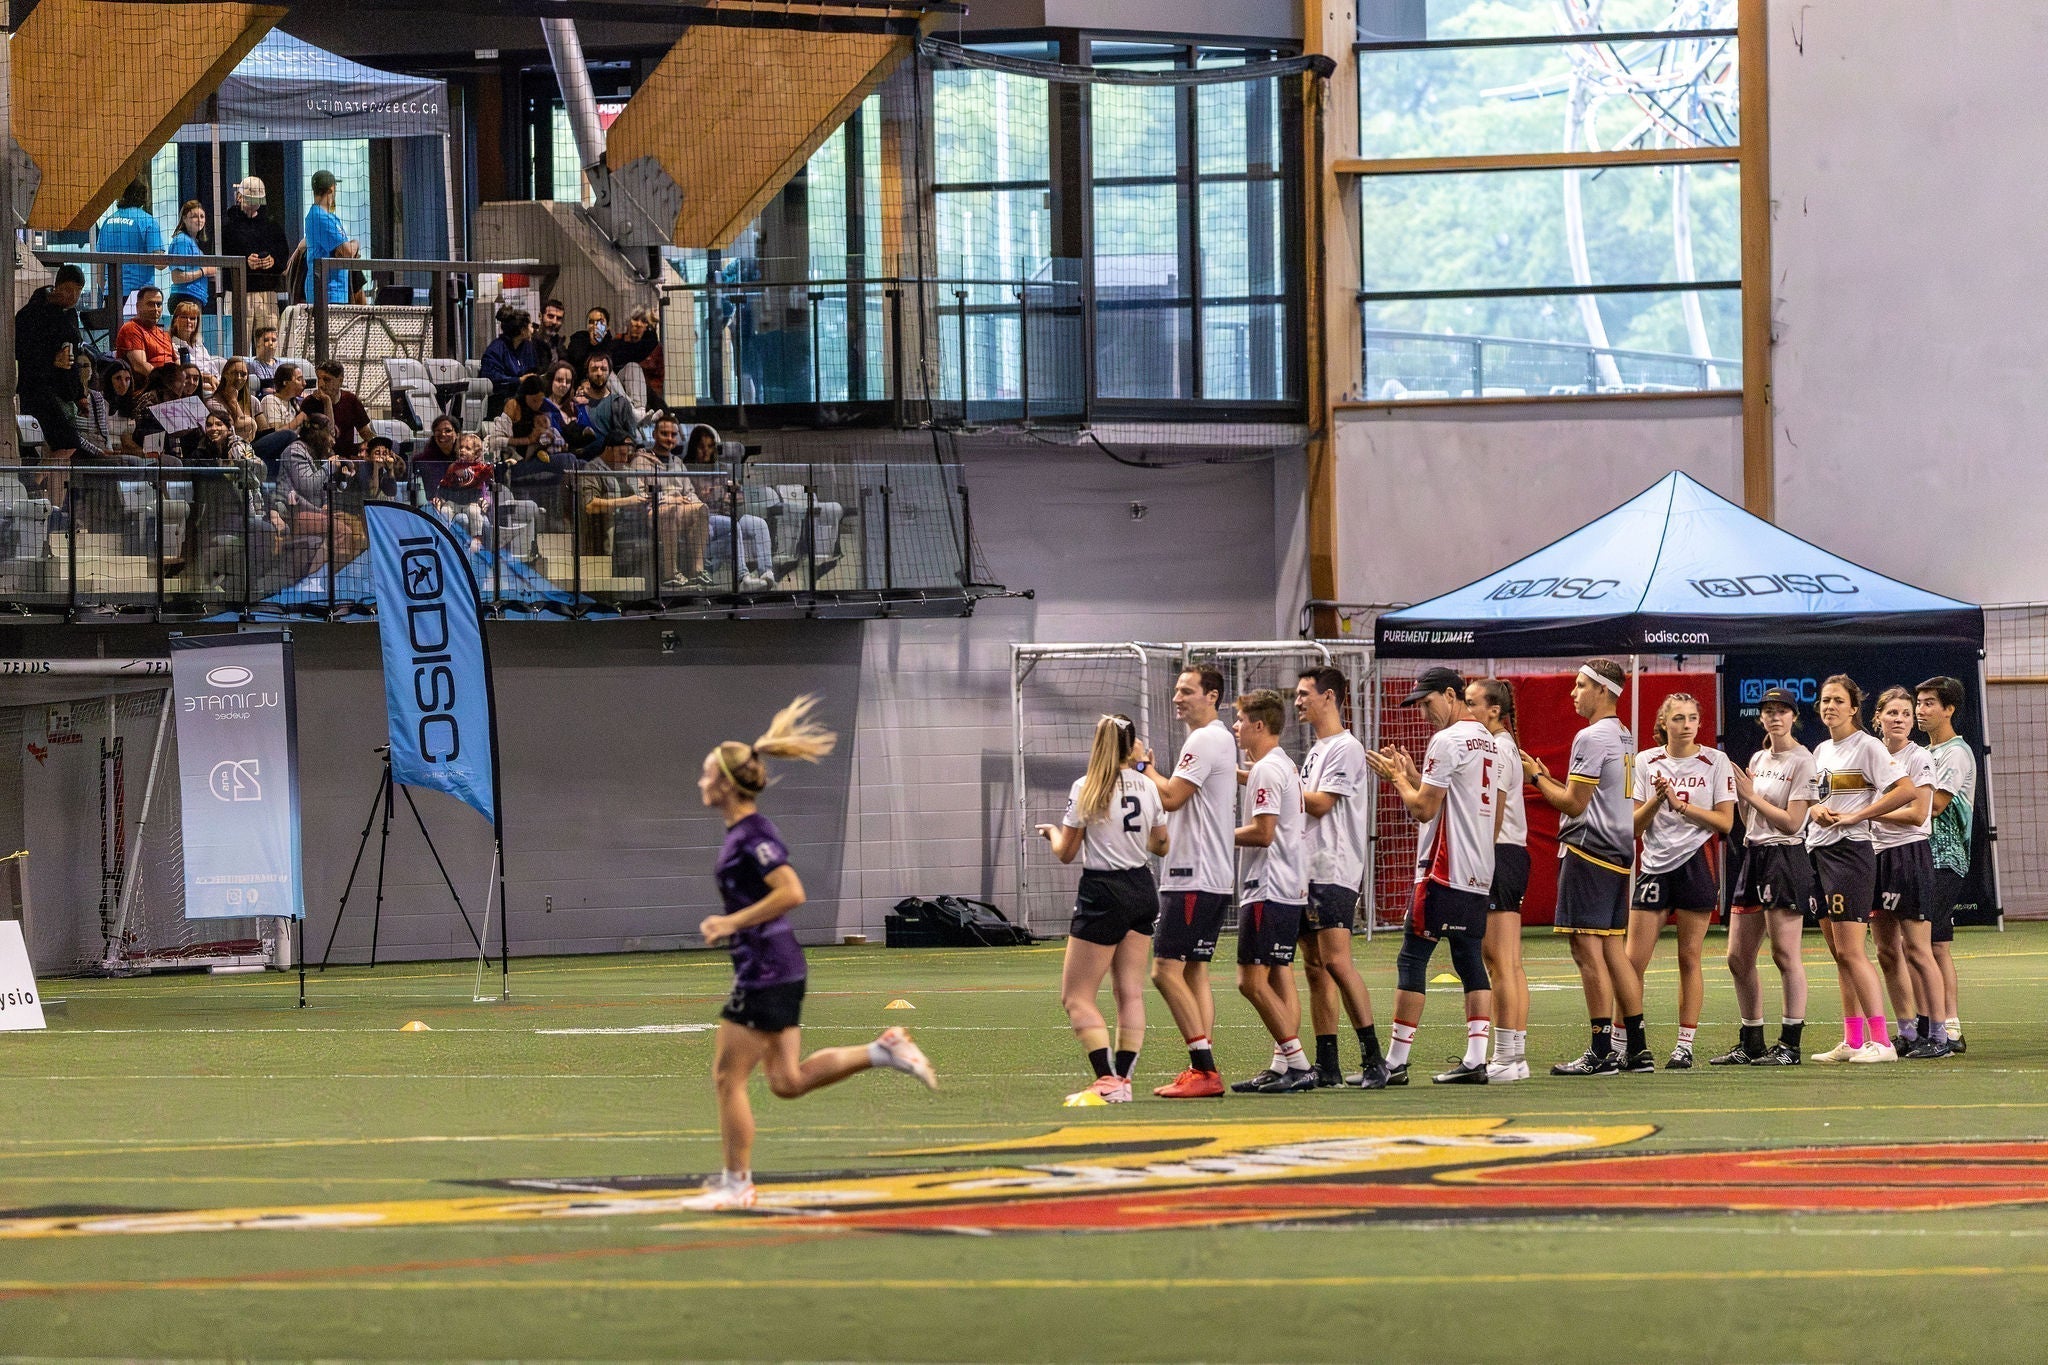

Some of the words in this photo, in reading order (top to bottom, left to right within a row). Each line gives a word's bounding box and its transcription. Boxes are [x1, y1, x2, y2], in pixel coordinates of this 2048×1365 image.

[1383, 630, 1430, 643] PUREMENT
[1644, 630, 1710, 643] iodisc.com
[3, 661, 50, 674] TELUS
[1650, 774, 1706, 788] CNADA
[1120, 795, 1142, 832] 2
[1640, 882, 1660, 903] 73
[1881, 891, 1901, 911] 27
